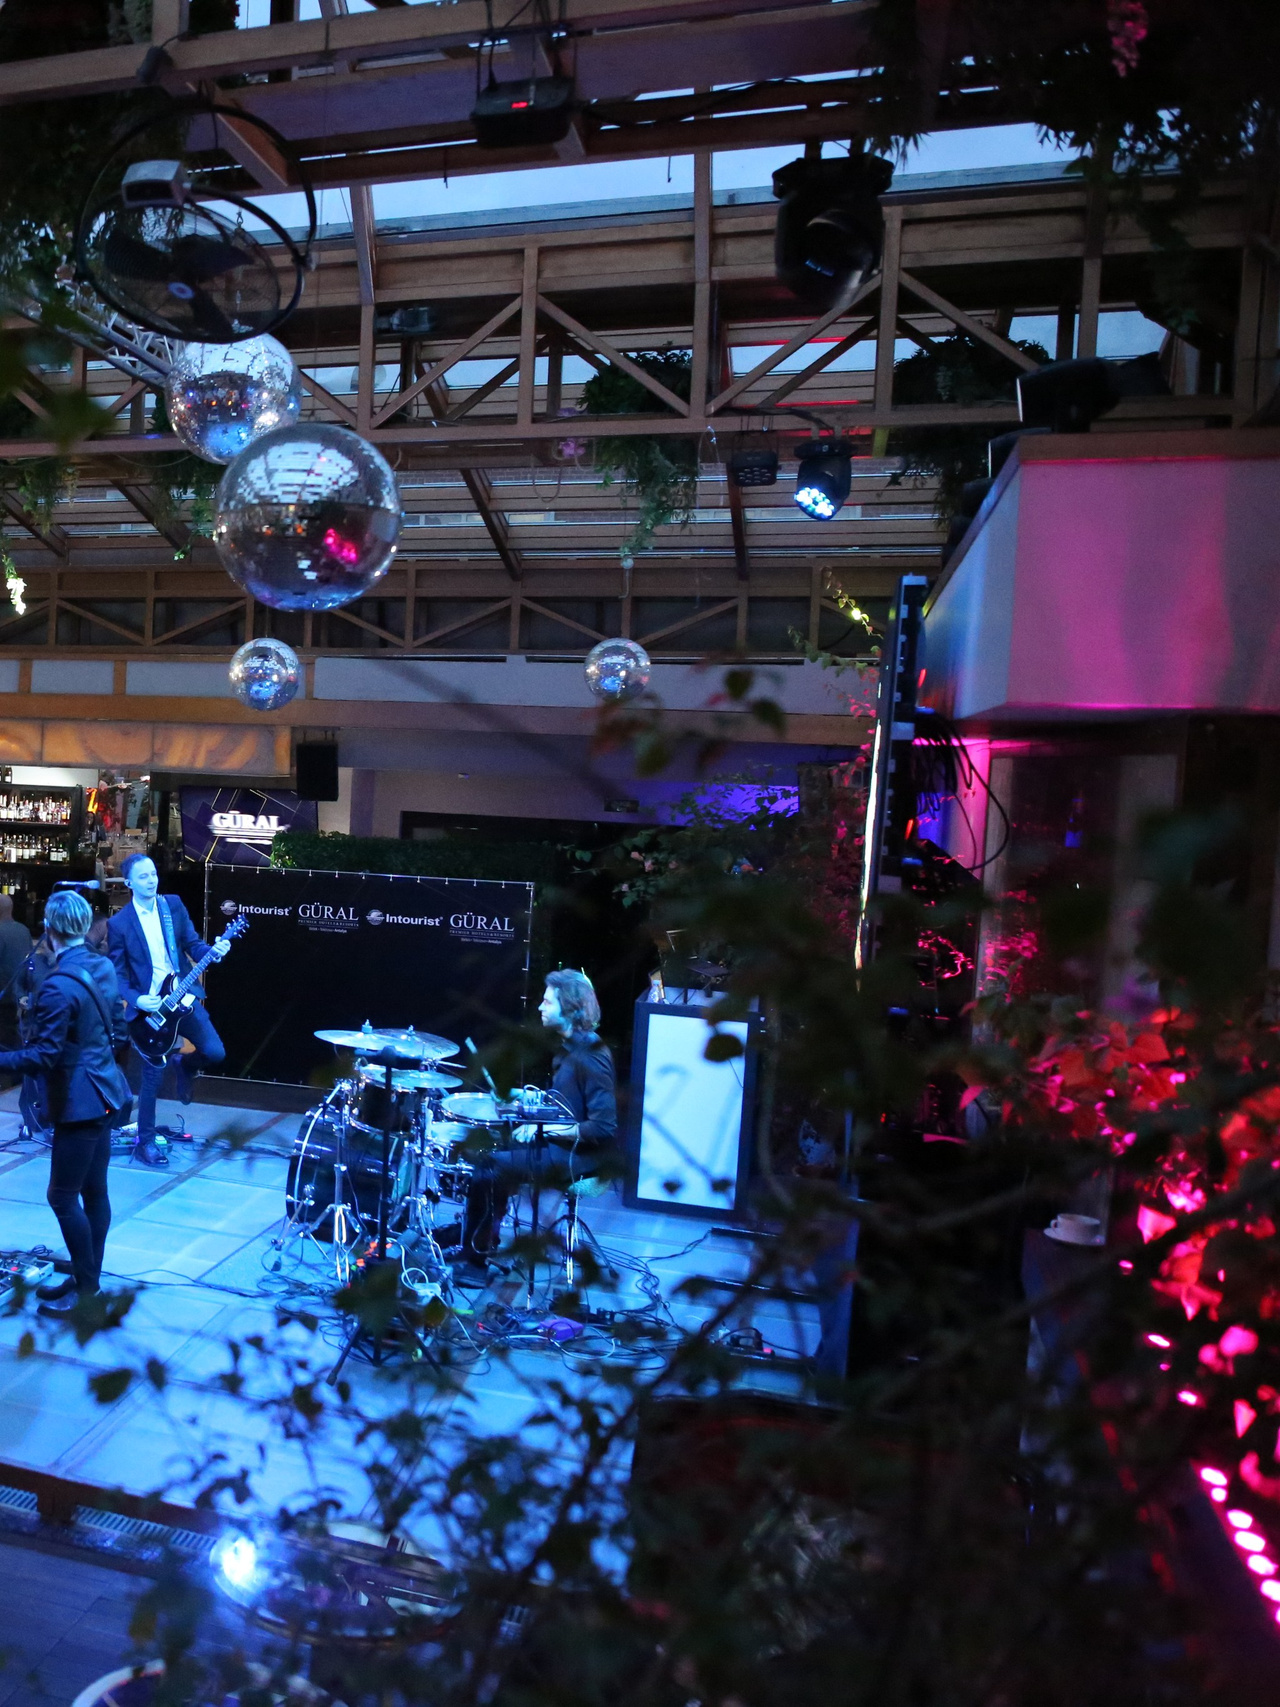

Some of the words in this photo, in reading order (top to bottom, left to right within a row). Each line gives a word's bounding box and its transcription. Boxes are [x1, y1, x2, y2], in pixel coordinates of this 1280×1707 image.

[211, 810, 285, 830] GÜRAL
[298, 902, 359, 921] GÜRAL
[449, 912, 515, 931] GÜRAL
